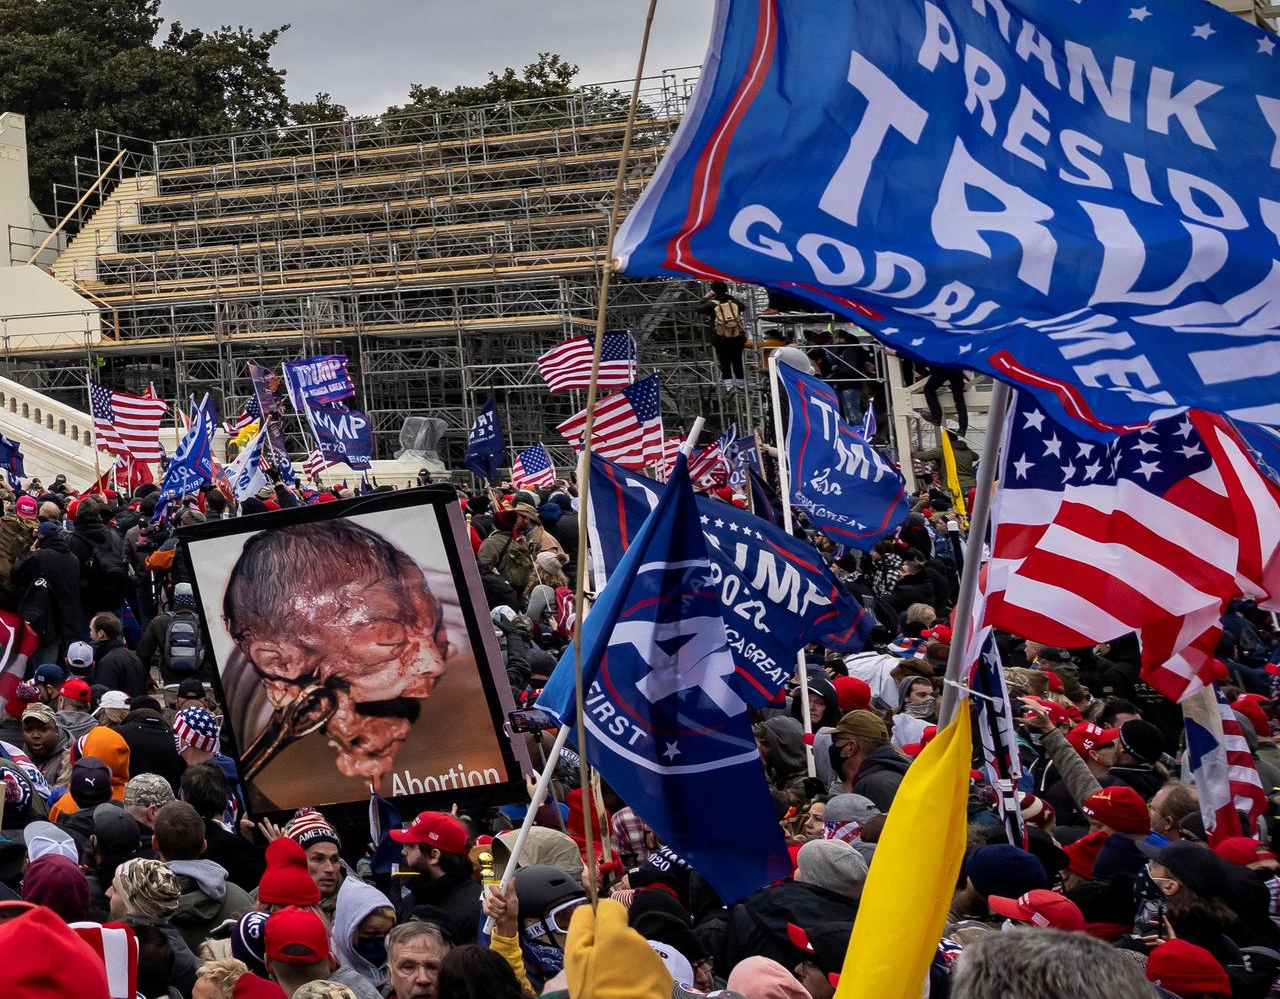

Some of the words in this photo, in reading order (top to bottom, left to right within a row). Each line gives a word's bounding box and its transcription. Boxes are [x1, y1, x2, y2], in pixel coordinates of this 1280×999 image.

[729, 203, 926, 305] GOD
[293, 359, 341, 387] TRUMP
[585, 680, 648, 746] FIRST
[392, 764, 500, 797] Abortion
